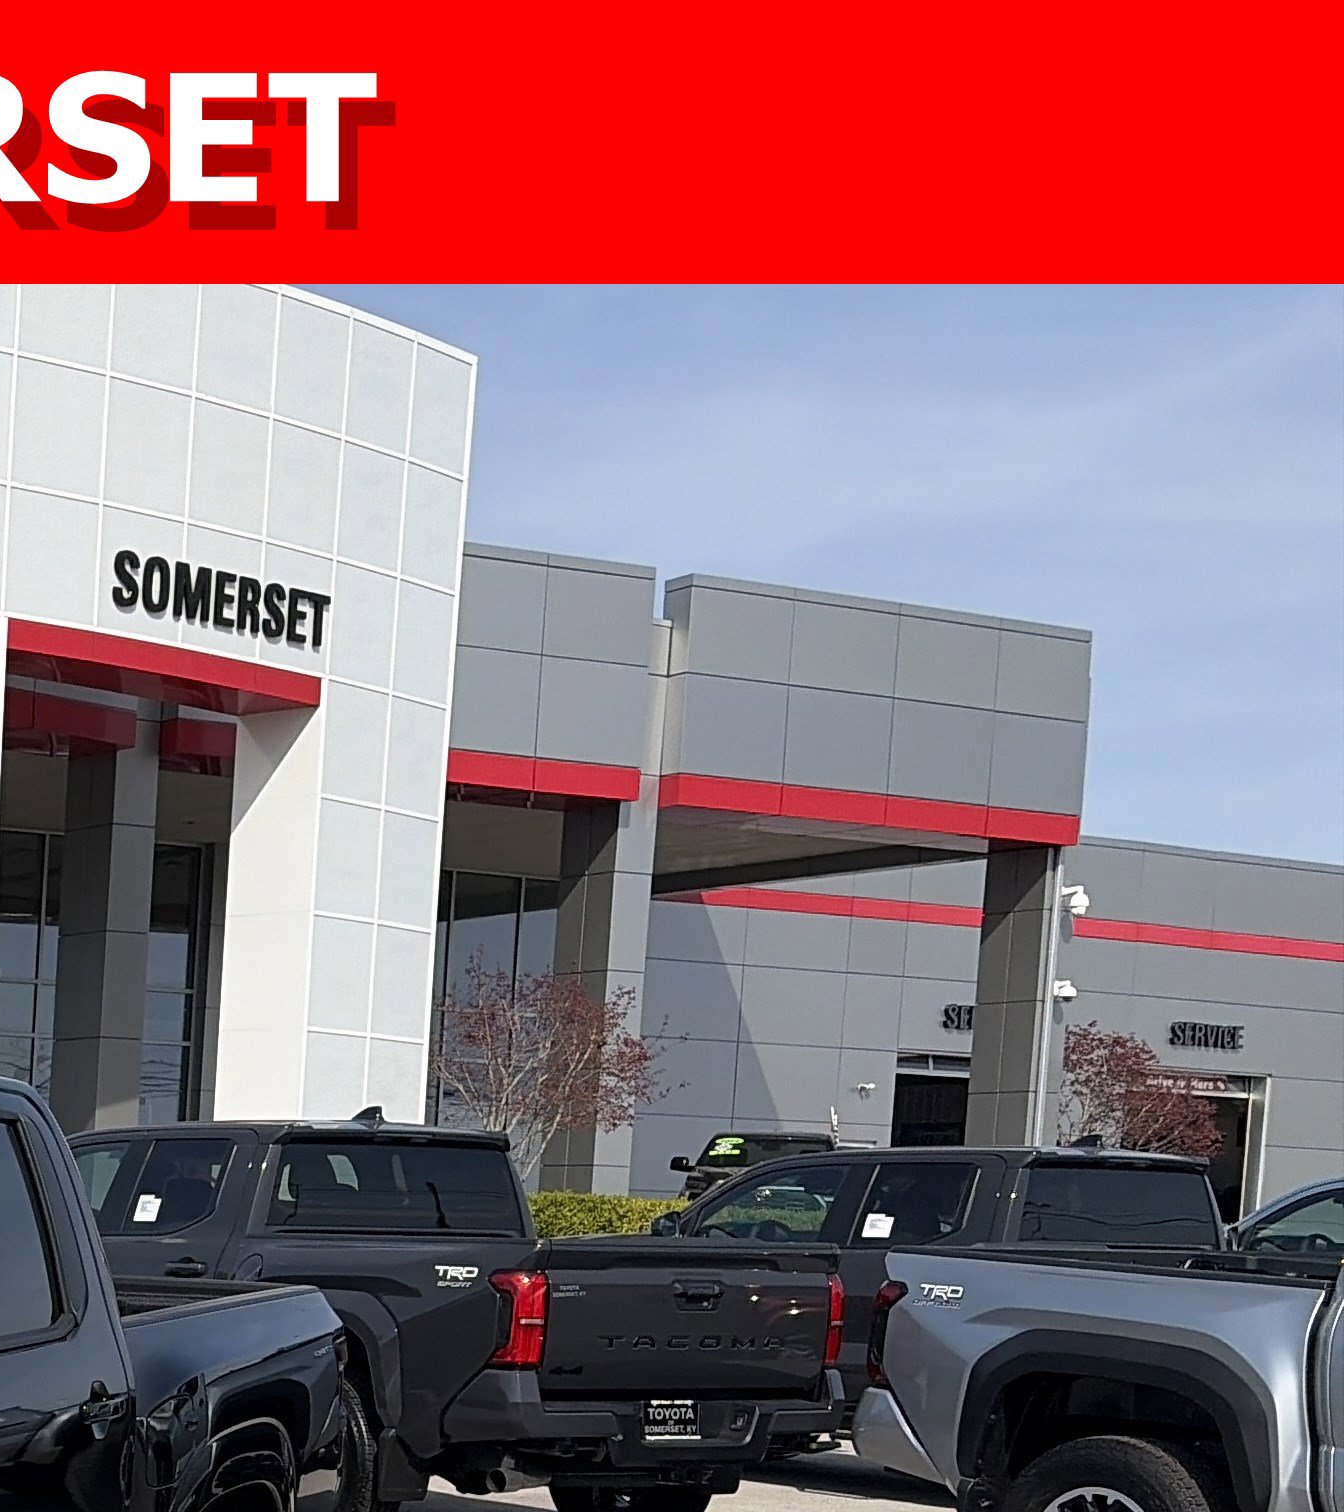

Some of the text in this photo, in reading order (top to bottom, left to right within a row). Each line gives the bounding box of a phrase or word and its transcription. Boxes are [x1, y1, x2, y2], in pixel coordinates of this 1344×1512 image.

[112, 549, 331, 649] SOMERSET
[1170, 1021, 1244, 1049] SERVICE
[434, 1265, 479, 1280] TRD
[920, 1283, 964, 1300] TRD
[597, 1335, 787, 1350] TACOMA
[647, 1407, 695, 1420] TOYOTA
